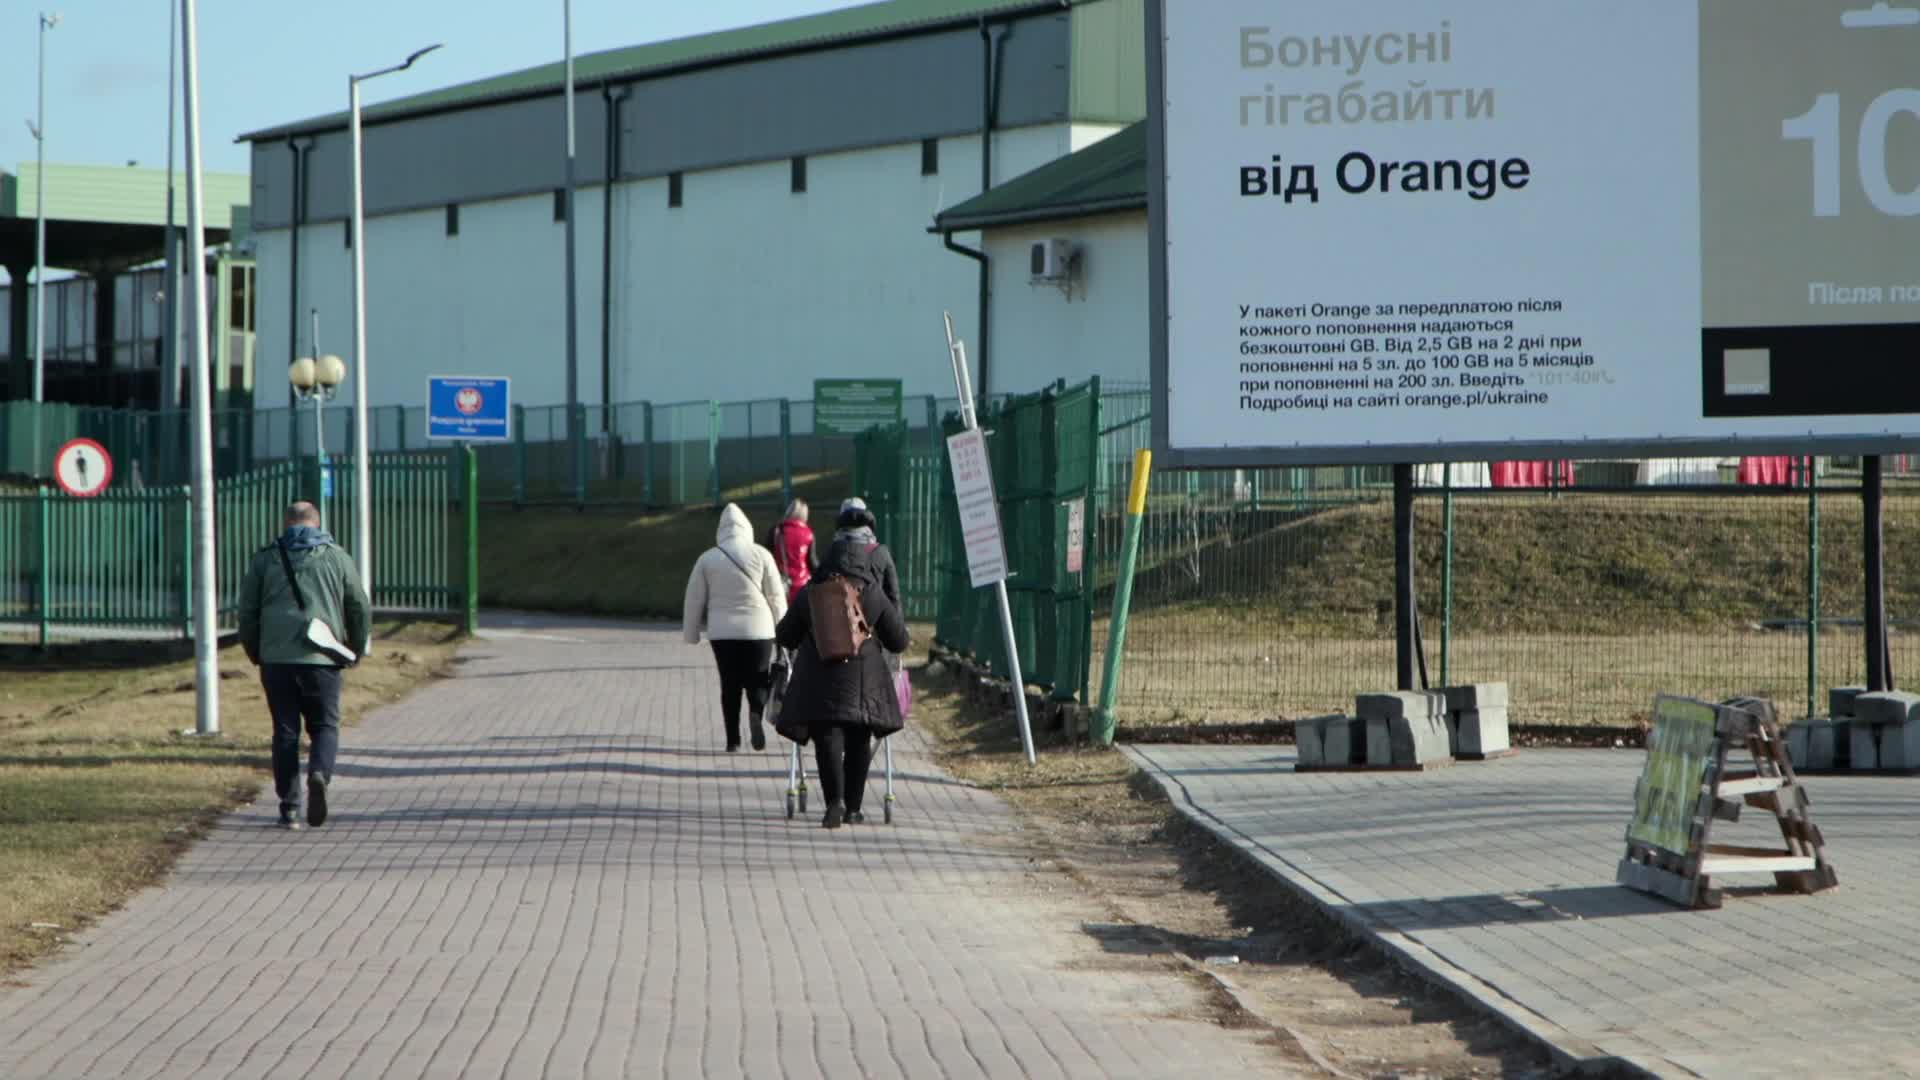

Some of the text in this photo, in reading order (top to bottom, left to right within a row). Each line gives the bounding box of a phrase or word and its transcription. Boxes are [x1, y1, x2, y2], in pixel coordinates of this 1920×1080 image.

[1239, 20, 1451, 76] Бонусні
[1239, 80, 1495, 126] гігабайти
[1240, 151, 1530, 203] від Orange
[1809, 282, 1881, 305] Після
[1239, 299, 1562, 319] У пакеті Orange за передплатою після
[1239, 320, 1513, 337] кожного поповнення надаються
[1240, 335, 1582, 355] безкоштовні GB. Від 2,5 GB на 2 дні при
[1239, 352, 1594, 373] поповненні на 5 зл. до 100 GB на 5 місяців
[1239, 379, 1269, 394] при
[1274, 376, 1368, 391] поповненні
[1374, 378, 1393, 388] на
[1398, 374, 1426, 388] 200
[1432, 376, 1454, 387] зл.
[1460, 373, 1524, 388] Введіть
[1240, 390, 1548, 412] Подробиці на сайті orange.pl/ukraine
